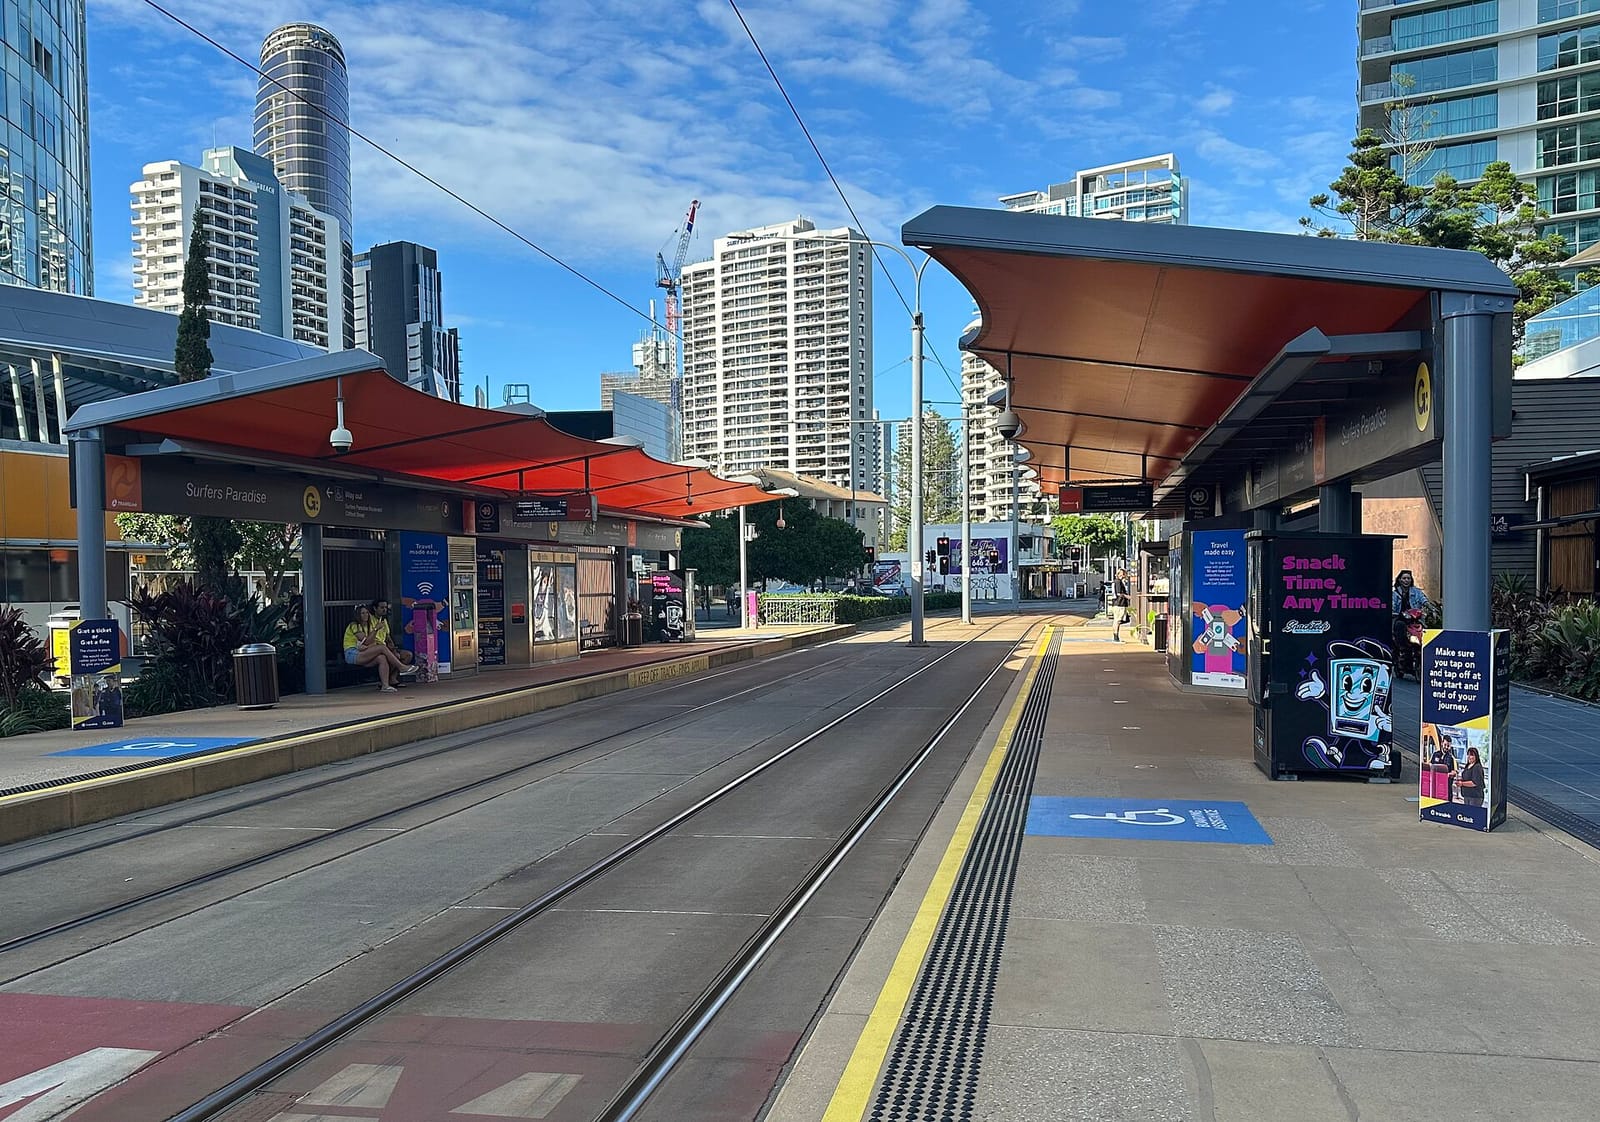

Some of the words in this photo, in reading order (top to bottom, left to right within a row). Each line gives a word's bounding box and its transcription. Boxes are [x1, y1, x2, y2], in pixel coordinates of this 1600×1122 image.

[1341, 422, 1360, 446] Surfers
[1361, 405, 1387, 435] Paradise
[185, 482, 223, 500] Surfers
[225, 486, 267, 504] Paradise
[1075, 501, 1079, 509] 1
[584, 509, 592, 518] 2
[1282, 554, 1346, 570] Snack
[1282, 575, 1342, 594] Time,
[1282, 595, 1325, 613] Any
[1327, 593, 1387, 609] Time.
[1435, 647, 1456, 657] Make
[1457, 650, 1475, 658] sure
[1434, 660, 1448, 668] you
[1449, 660, 1463, 670] tap
[638, 671, 650, 685] KEEP
[650, 668, 659, 682] OFF
[660, 664, 676, 679] TRACKS
[1429, 669, 1442, 677] and
[1444, 670, 1457, 680] tap
[1459, 670, 1470, 679] off
[1472, 672, 1481, 680] at
[1430, 678, 1443, 687] the
[1444, 681, 1462, 690] start
[1463, 681, 1479, 691] and
[1432, 690, 1446, 698] end
[1447, 690, 1457, 699] of
[1457, 693, 1477, 702] your
[1438, 700, 1469, 713] journey.
